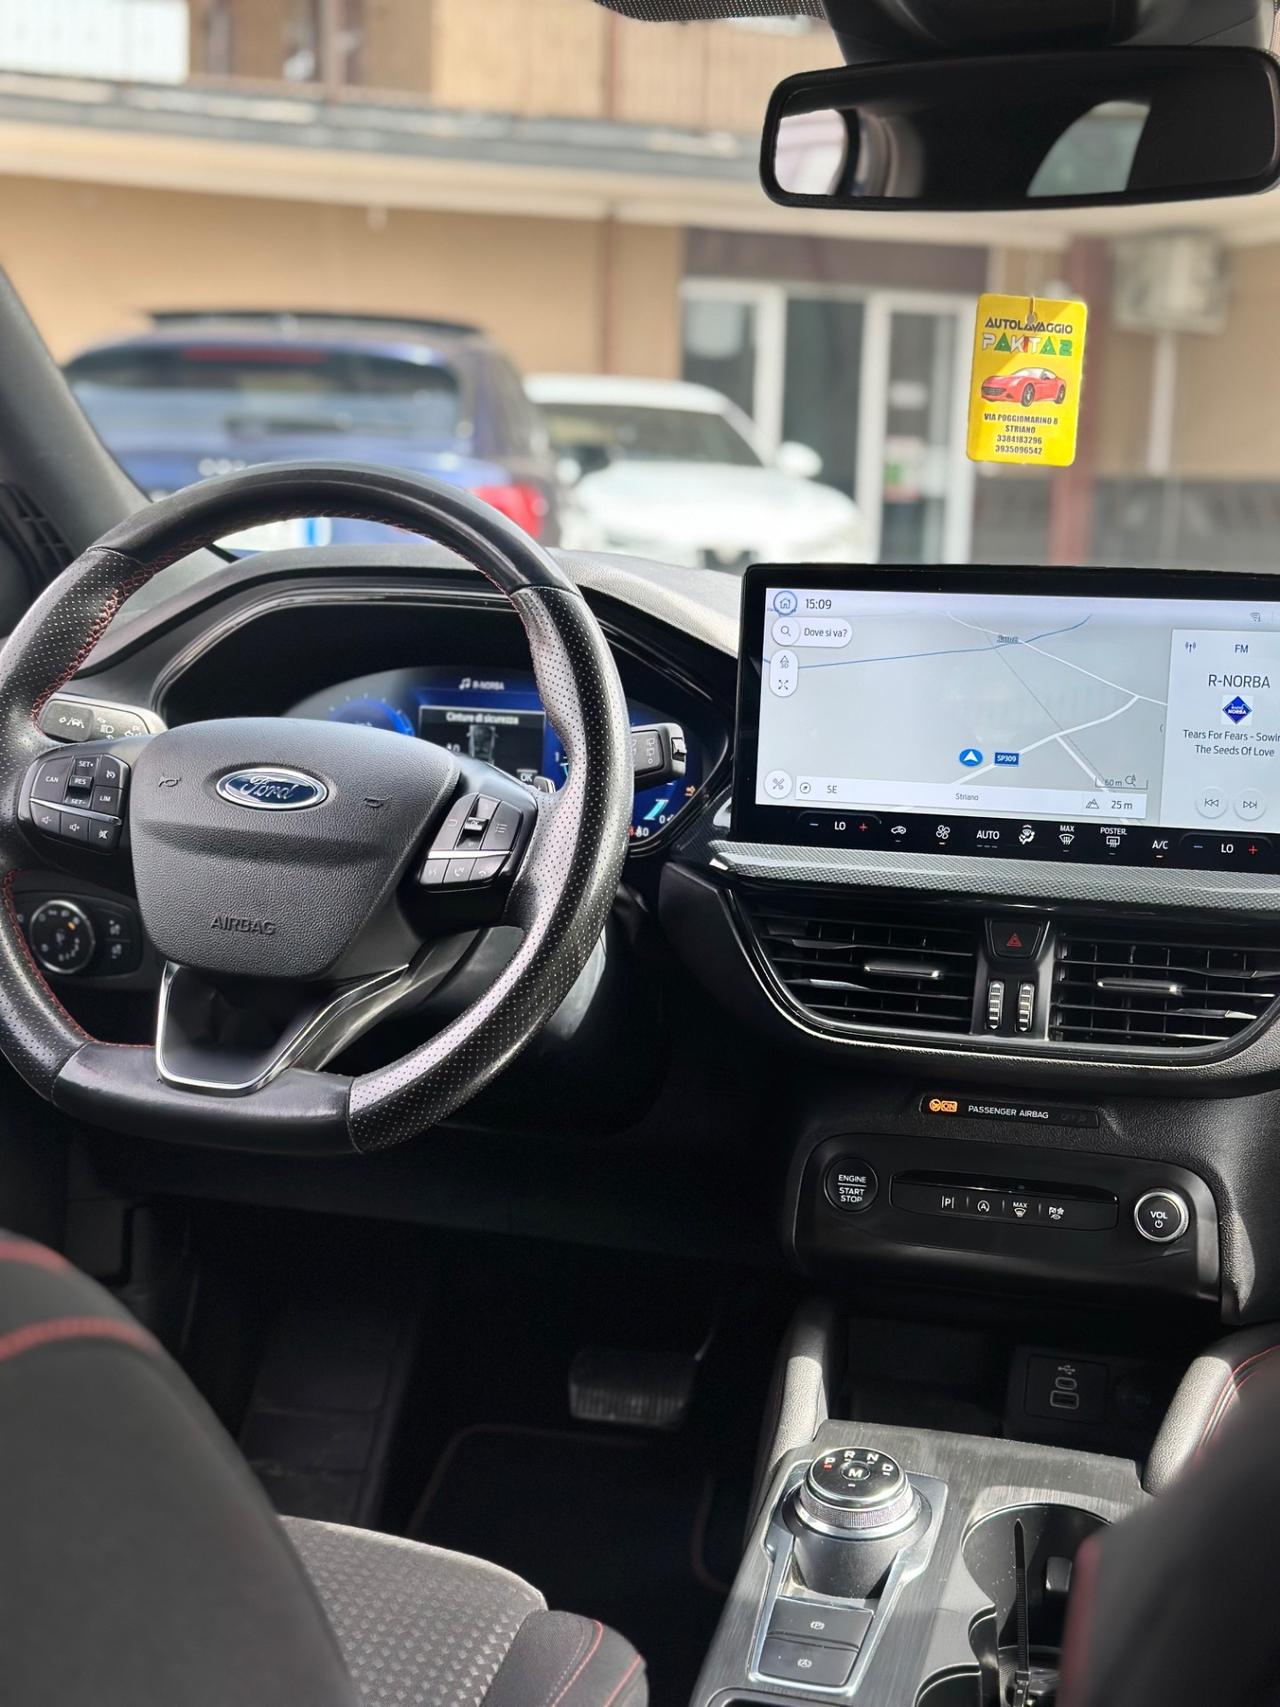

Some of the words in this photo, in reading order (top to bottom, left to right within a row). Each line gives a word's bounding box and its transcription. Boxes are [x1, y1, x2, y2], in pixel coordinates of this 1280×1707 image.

[985, 317, 1073, 334] AUTOLAVAGGIO
[984, 413, 996, 421] VIA
[998, 414, 1052, 425] POGGIOMARINO
[1005, 424, 1036, 434] STRIANO
[805, 598, 832, 610] 15:09
[804, 627, 824, 637] Dove
[833, 628, 848, 638] va?
[1234, 644, 1249, 654] FM
[1208, 673, 1271, 689] R-NORBA
[1183, 729, 1207, 740] Tears
[1208, 730, 1223, 741] For
[1224, 730, 1248, 742] Fears
[1195, 744, 1212, 755] The
[1213, 745, 1240, 756] Seeds
[1241, 746, 1252, 756] Of
[1253, 747, 1275, 758] Love
[997, 754, 1017, 763] SP309
[45, 775, 59, 783] CAN
[74, 777, 87, 785] RES
[239, 775, 300, 800] Ford
[827, 785, 838, 794] SE
[955, 792, 979, 801] Striano
[1111, 800, 1122, 810] 25
[1123, 802, 1133, 810] m
[834, 820, 846, 831] LO
[1060, 825, 1075, 833] MAX
[976, 829, 1000, 840] AUTO
[1152, 840, 1169, 850] A/C
[1220, 843, 1234, 854] LO
[210, 916, 276, 935] AIRBAG
[968, 1105, 1017, 1117] PASSENGER
[1019, 1109, 1049, 1119] AIRBAG
[838, 1174, 867, 1184] ENGINE
[839, 1186, 865, 1196] START
[840, 1194, 863, 1203] STOP
[1150, 1210, 1168, 1220] VOL
[824, 1457, 836, 1465] P
[844, 1450, 856, 1459] R
[866, 1453, 880, 1462] N
[881, 1463, 894, 1472] D
[848, 1468, 864, 1478] M
